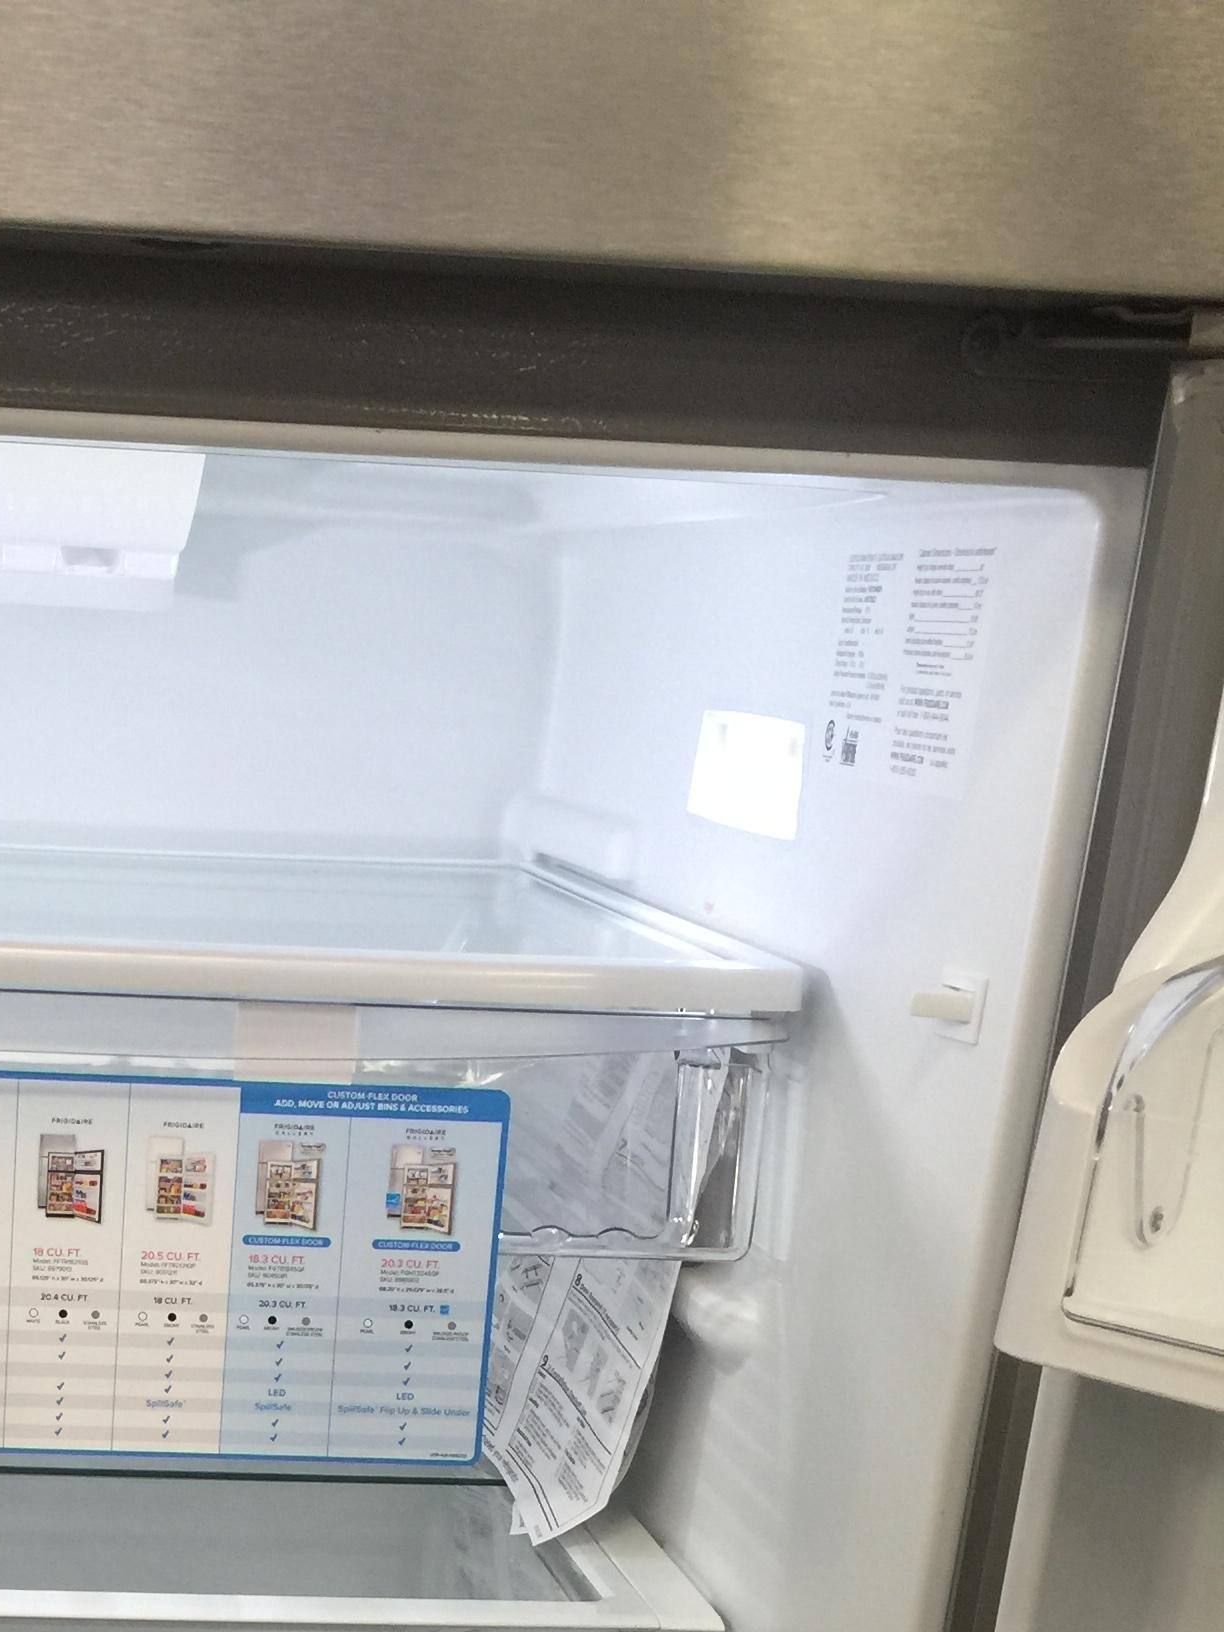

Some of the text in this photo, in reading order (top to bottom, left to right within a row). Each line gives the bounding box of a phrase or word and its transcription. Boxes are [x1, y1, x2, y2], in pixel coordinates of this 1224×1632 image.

[391, 1094, 418, 1102] DOOR
[275, 1099, 470, 1115] ADD, MOVE OR ADJUST BINS & ACCESSORIES
[274, 1123, 315, 1131] FRIGIDAIRE
[33, 1248, 45, 1256] 18
[141, 1251, 164, 1261] 20.5
[248, 1254, 269, 1264] 18.3
[380, 1259, 404, 1269] 20.3
[575, 1274, 583, 1286] 8
[258, 1300, 277, 1308] 20.3
[540, 1355, 550, 1367] 9
[268, 1388, 286, 1397] LED
[396, 1392, 415, 1401] LED
[380, 1406, 396, 1415] Flip
[397, 1407, 411, 1416] Up
[412, 1407, 419, 1415] &
[421, 1407, 441, 1416] Slide
[443, 1408, 471, 1417] Under
